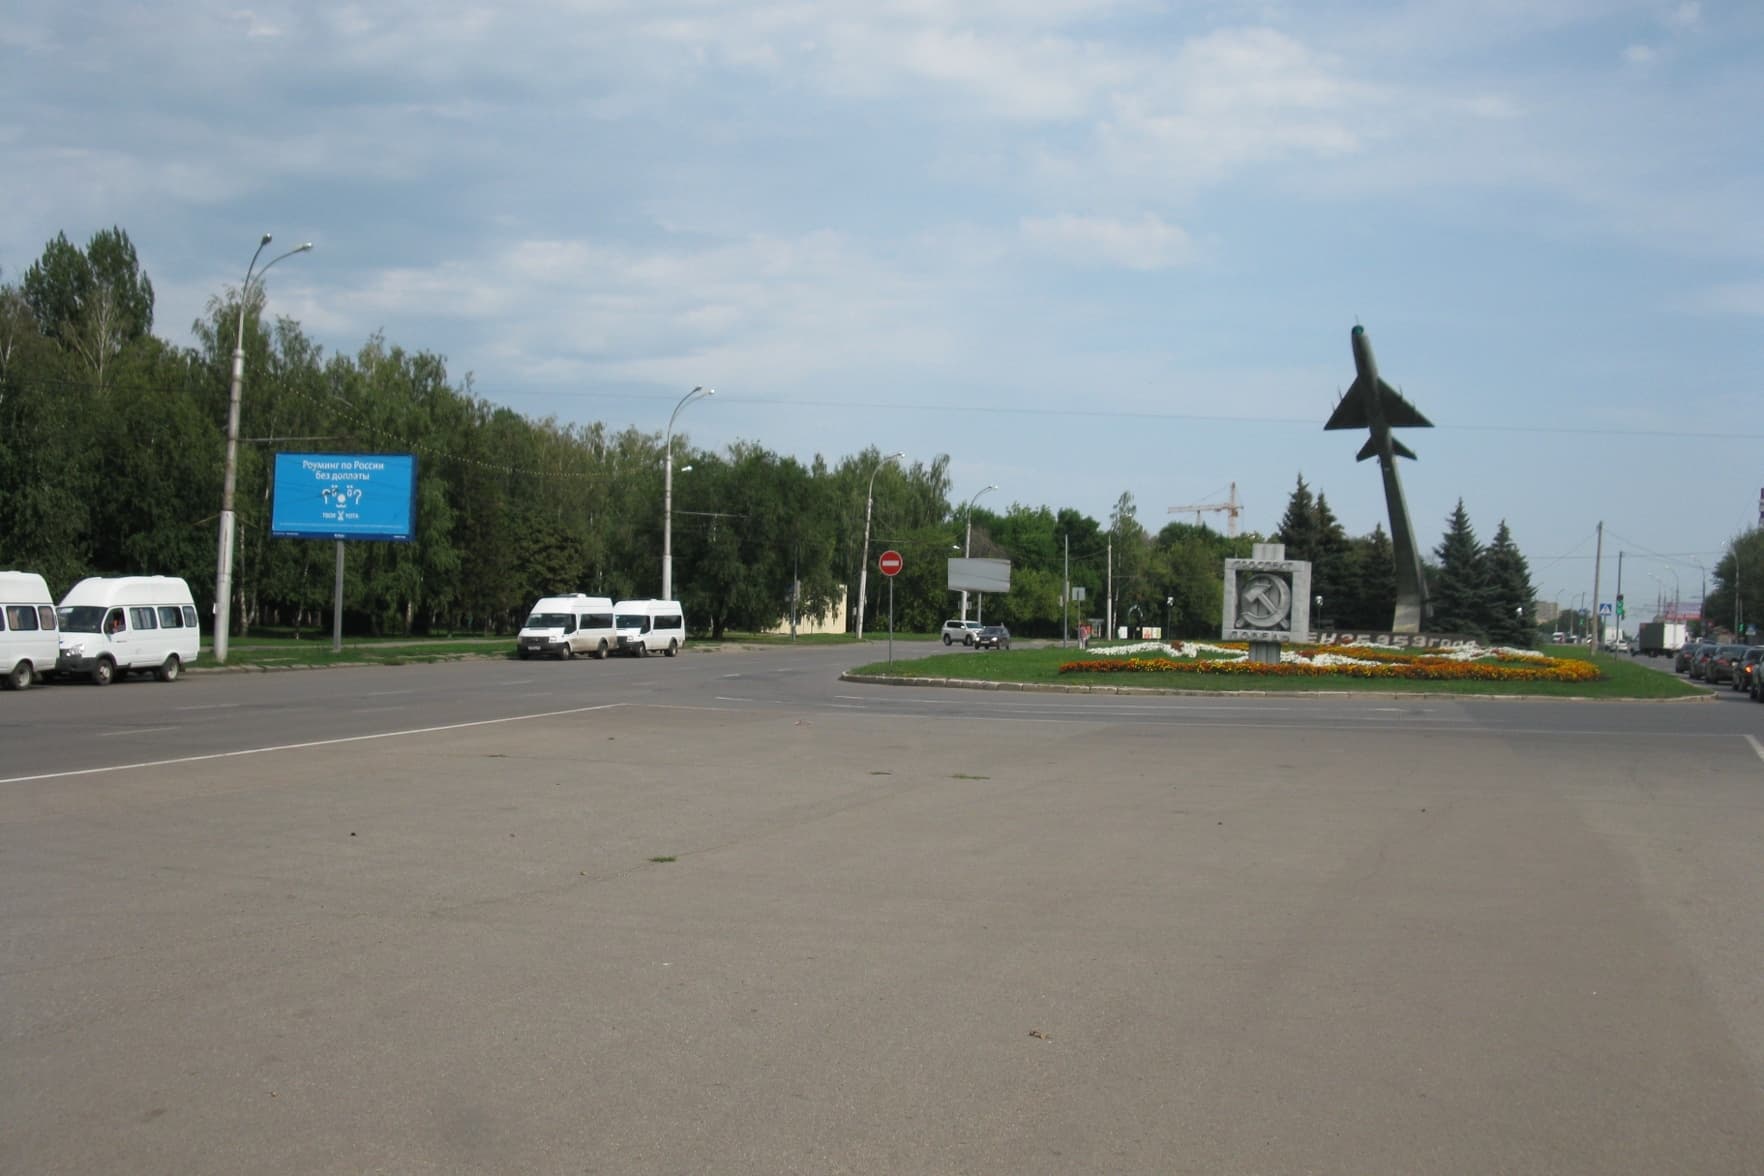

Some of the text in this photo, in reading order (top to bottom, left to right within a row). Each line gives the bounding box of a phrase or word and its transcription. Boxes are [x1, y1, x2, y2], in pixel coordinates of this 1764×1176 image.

[302, 460, 384, 471] Роуминг по России
[315, 471, 370, 481] без доплаты
